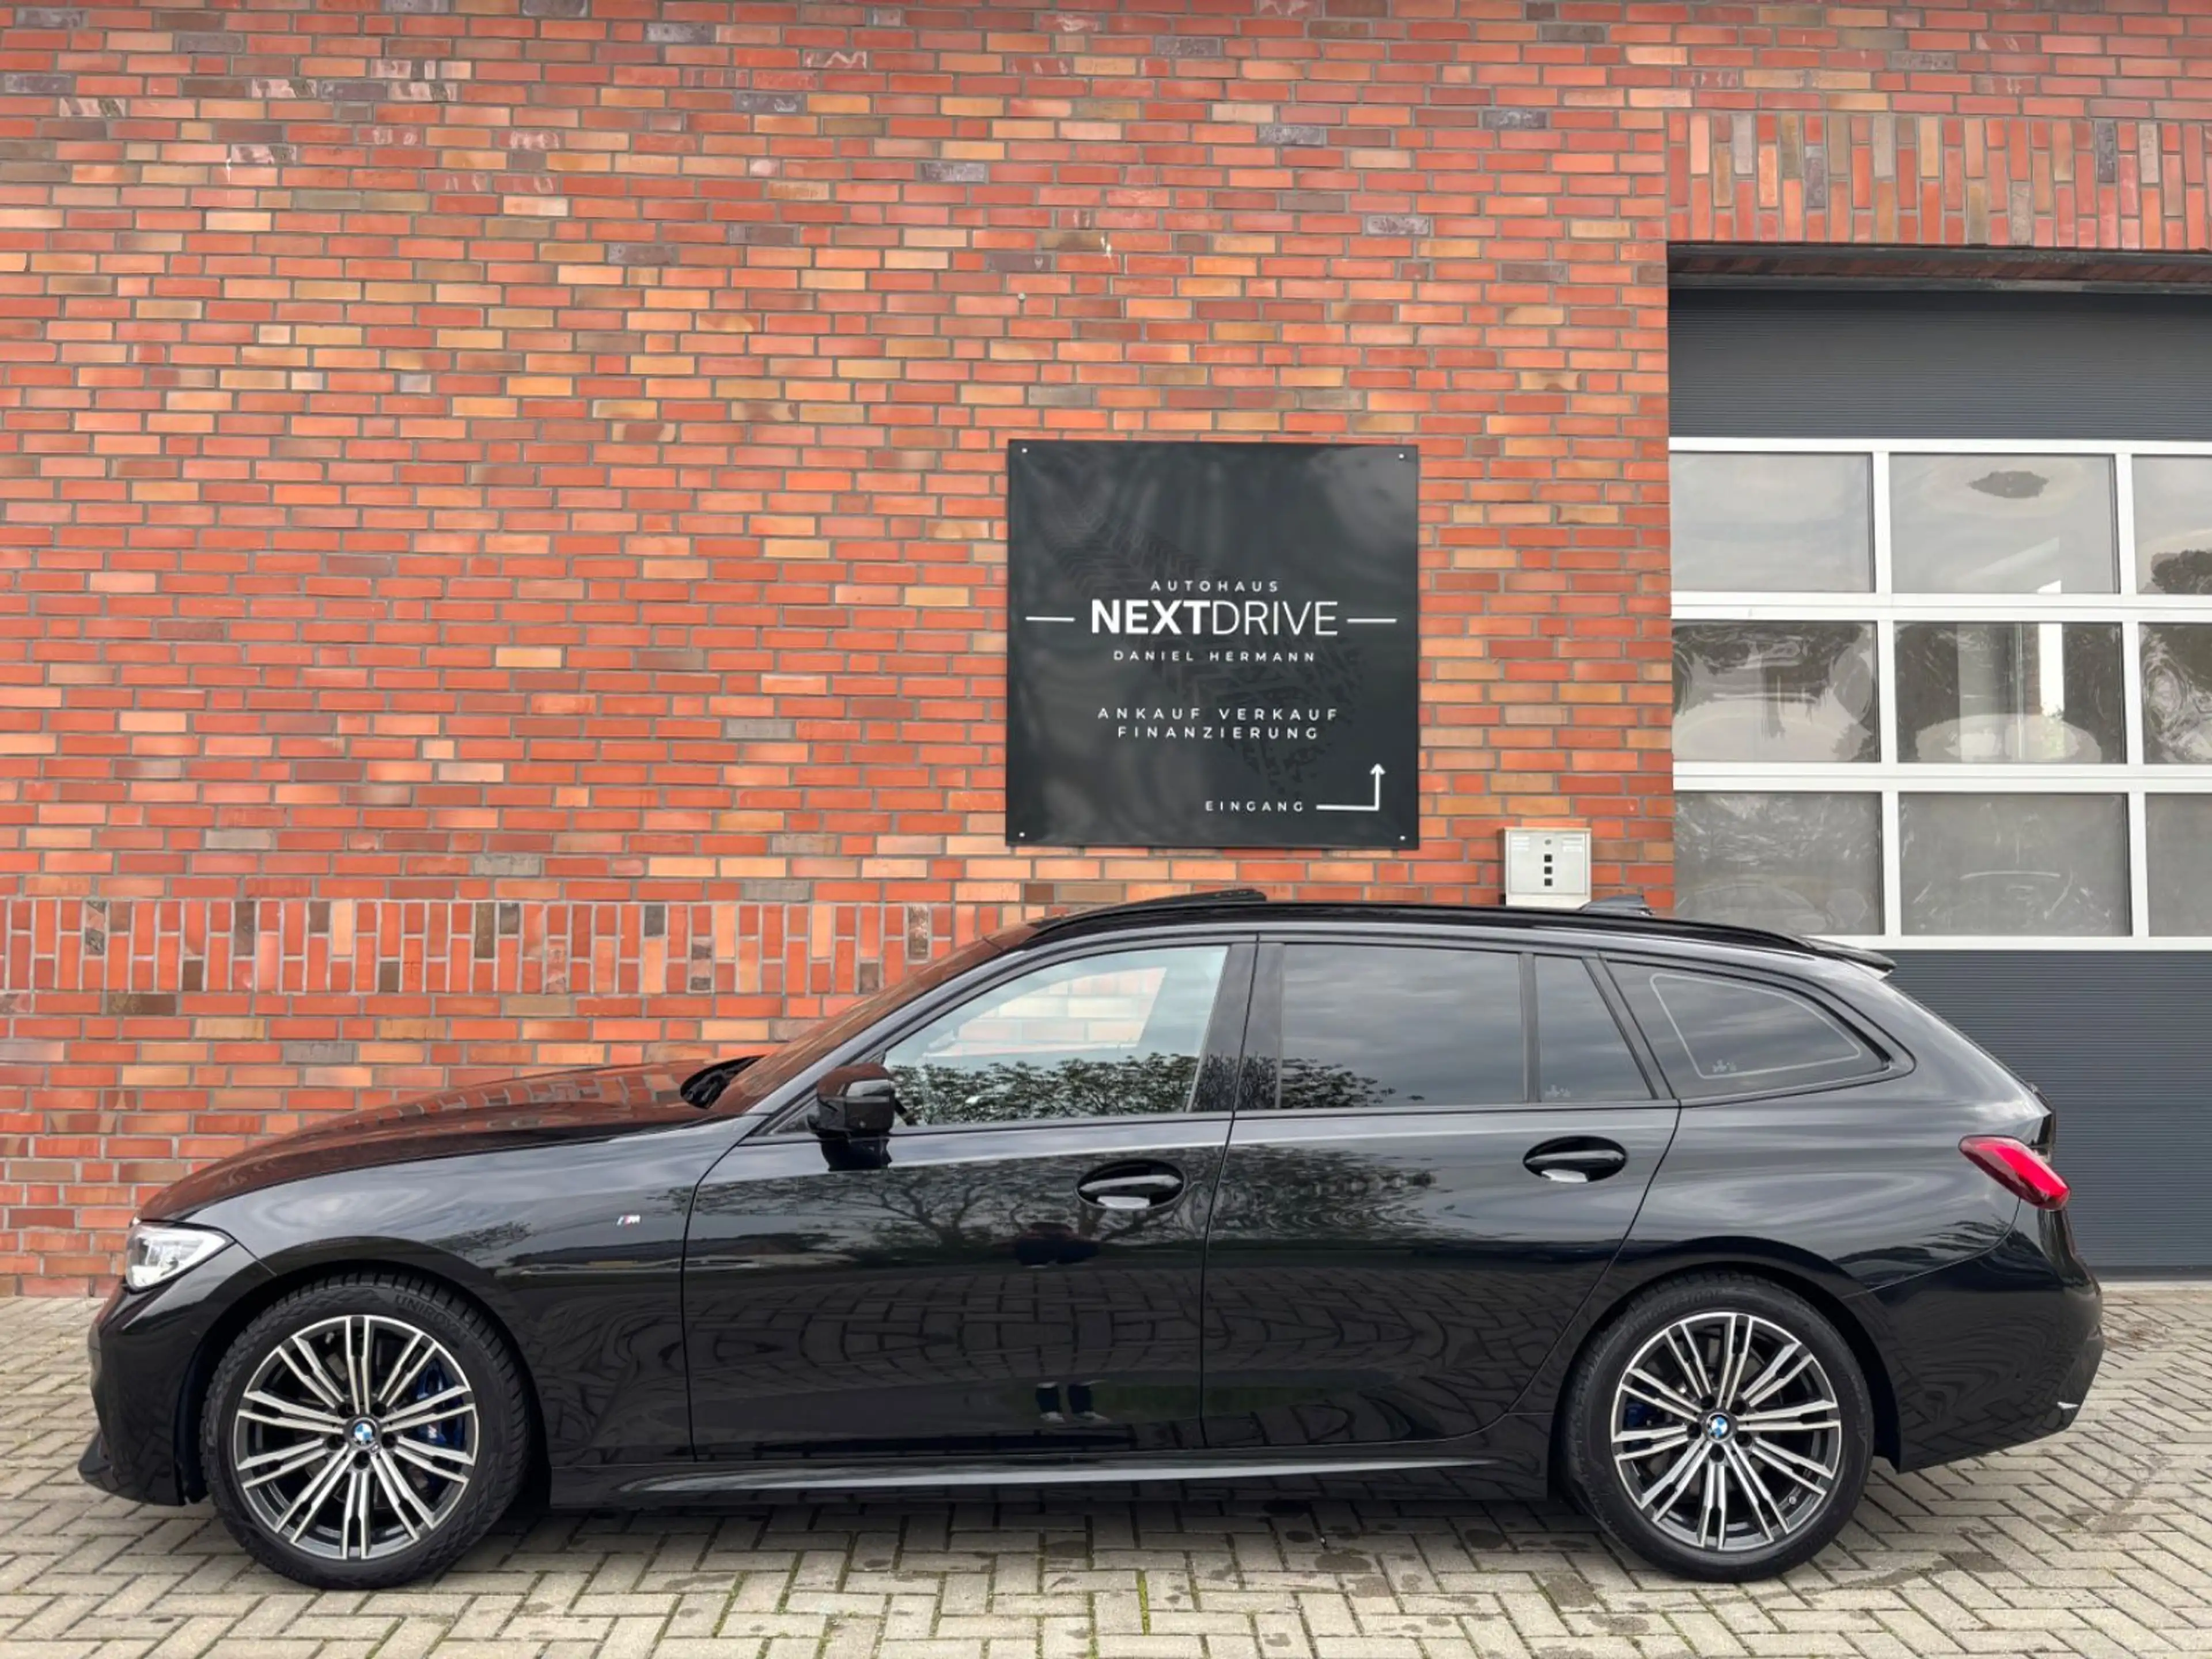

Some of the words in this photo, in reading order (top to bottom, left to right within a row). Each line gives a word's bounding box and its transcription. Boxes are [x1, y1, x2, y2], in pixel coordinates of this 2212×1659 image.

[1150, 581, 1277, 592] AUTOHAUS
[1092, 599, 1338, 635] NEXTDRIVE
[1113, 650, 1194, 661] DANIEL
[1209, 652, 1315, 662] HERMANN
[1097, 708, 1200, 720] ANKAUF
[1218, 709, 1337, 721] VERKAUF
[1118, 726, 1316, 740] FINANZIERUNG
[1205, 800, 1303, 812] EINGANG
